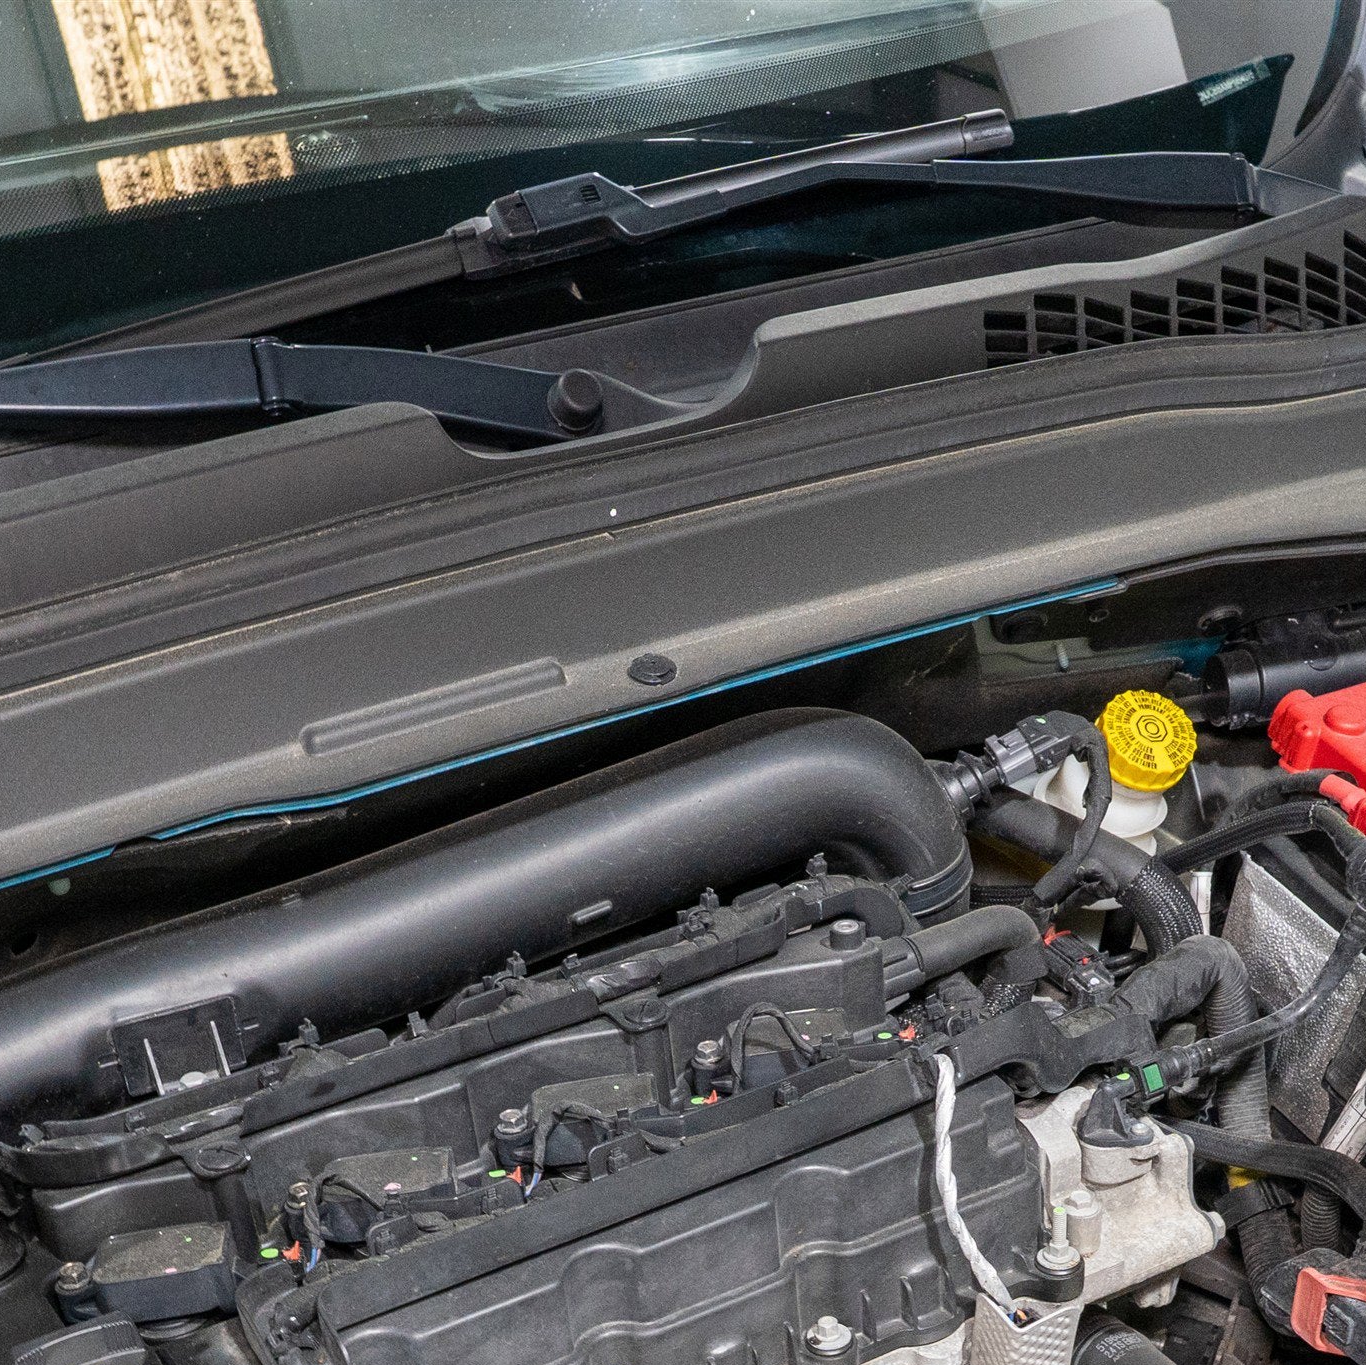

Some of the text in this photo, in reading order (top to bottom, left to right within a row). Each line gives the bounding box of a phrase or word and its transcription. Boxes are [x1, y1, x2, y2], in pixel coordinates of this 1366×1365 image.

[1132, 748, 1143, 757] USE
[1135, 741, 1153, 754] FILLER
[1128, 754, 1158, 770] CONTAINER
